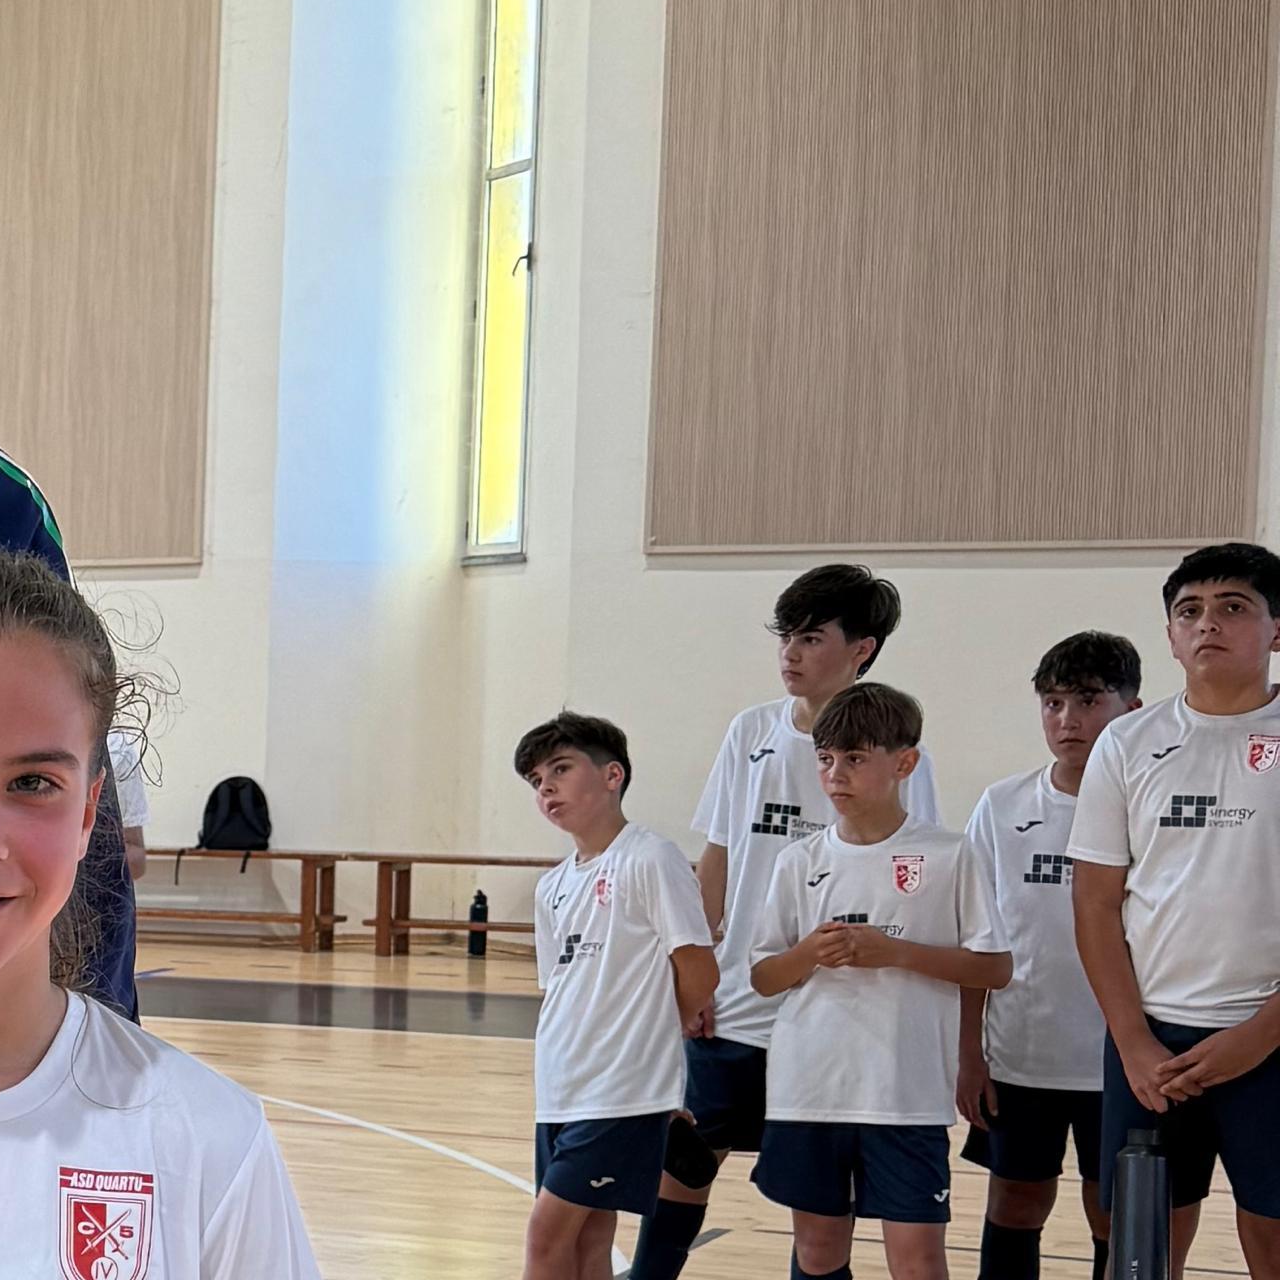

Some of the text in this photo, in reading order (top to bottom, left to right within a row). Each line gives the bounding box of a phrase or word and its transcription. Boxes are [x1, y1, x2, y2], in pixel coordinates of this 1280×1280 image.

[70, 1172, 143, 1191] ASD QUARTU
[119, 1225, 134, 1239] 5
[95, 1261, 114, 1280] IV
